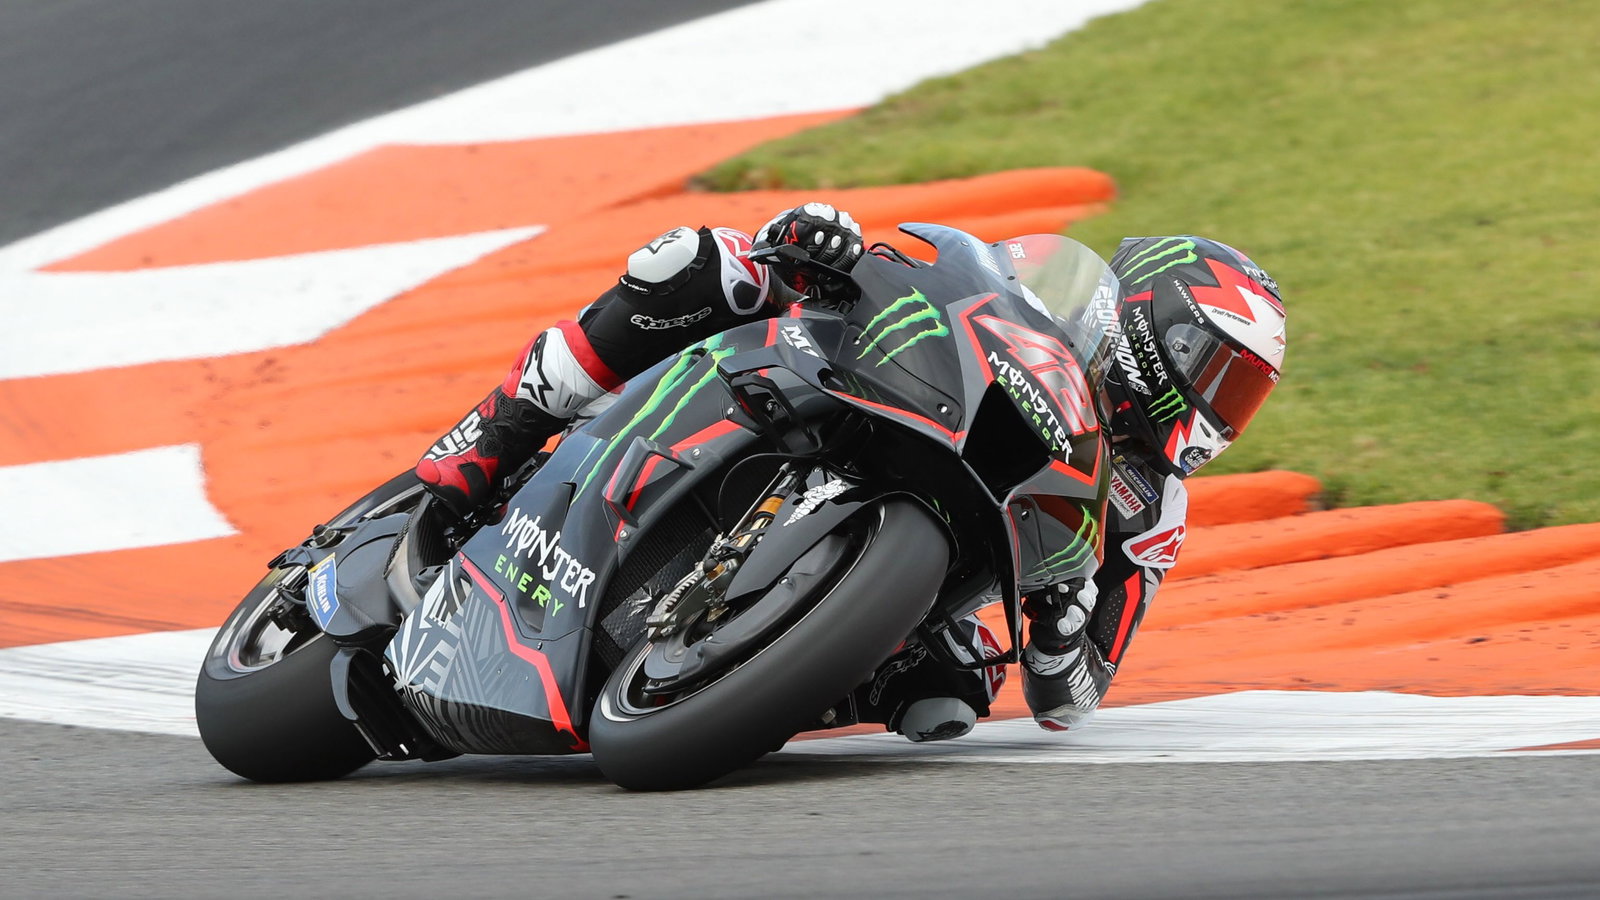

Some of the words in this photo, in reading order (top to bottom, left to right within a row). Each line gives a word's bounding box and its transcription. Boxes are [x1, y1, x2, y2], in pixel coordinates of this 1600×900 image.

[1173, 279, 1205, 325] HAWKERS
[1224, 312, 1251, 326] Performance
[1128, 324, 1151, 377] ENERGY
[1132, 306, 1168, 385] MONSTER
[972, 314, 1098, 436] 42
[987, 351, 1073, 464] MONSTER
[996, 375, 1059, 452] ENERGY
[1111, 475, 1142, 514] YAMAHA
[1126, 469, 1153, 498] MICHELIN
[494, 554, 564, 617] ENERY
